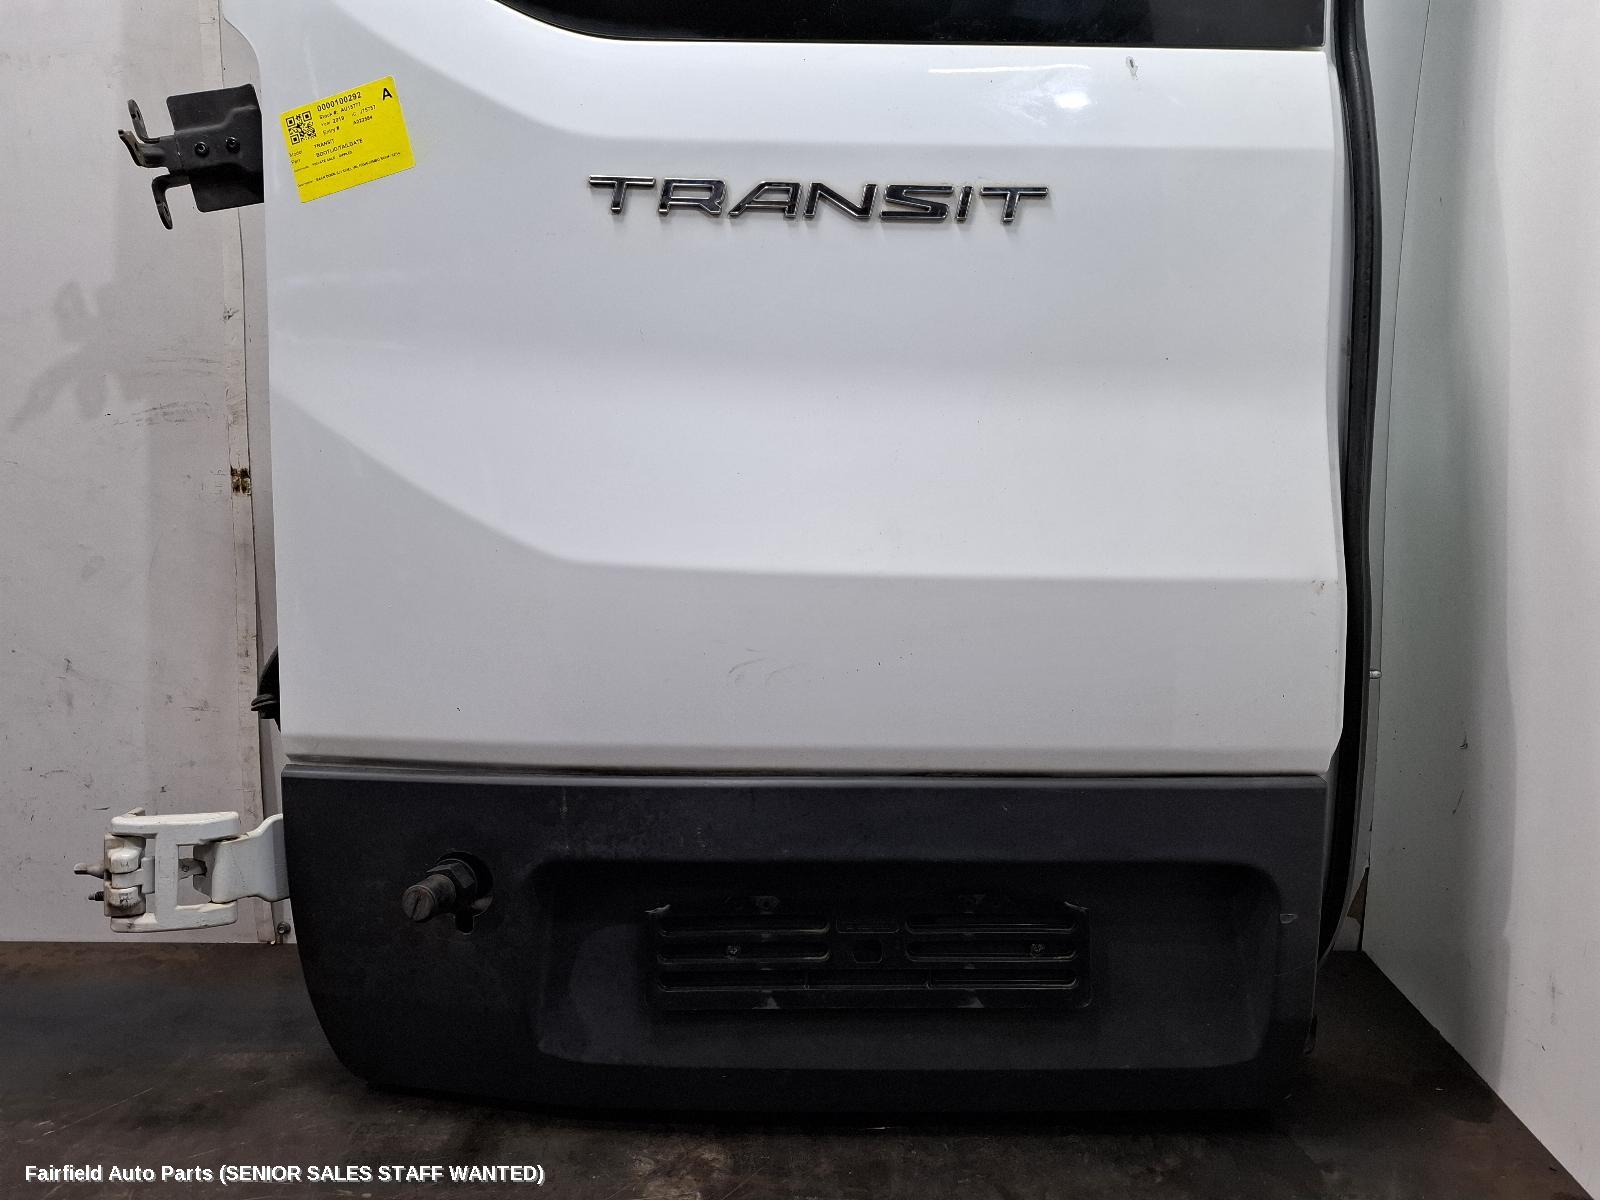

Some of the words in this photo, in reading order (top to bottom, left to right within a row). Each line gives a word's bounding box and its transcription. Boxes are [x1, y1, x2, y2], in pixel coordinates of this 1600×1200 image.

[316, 91, 362, 112] 0000100292
[382, 87, 393, 101] A
[313, 138, 335, 149] TRANSIT
[588, 174, 1049, 223] TRANSIT
